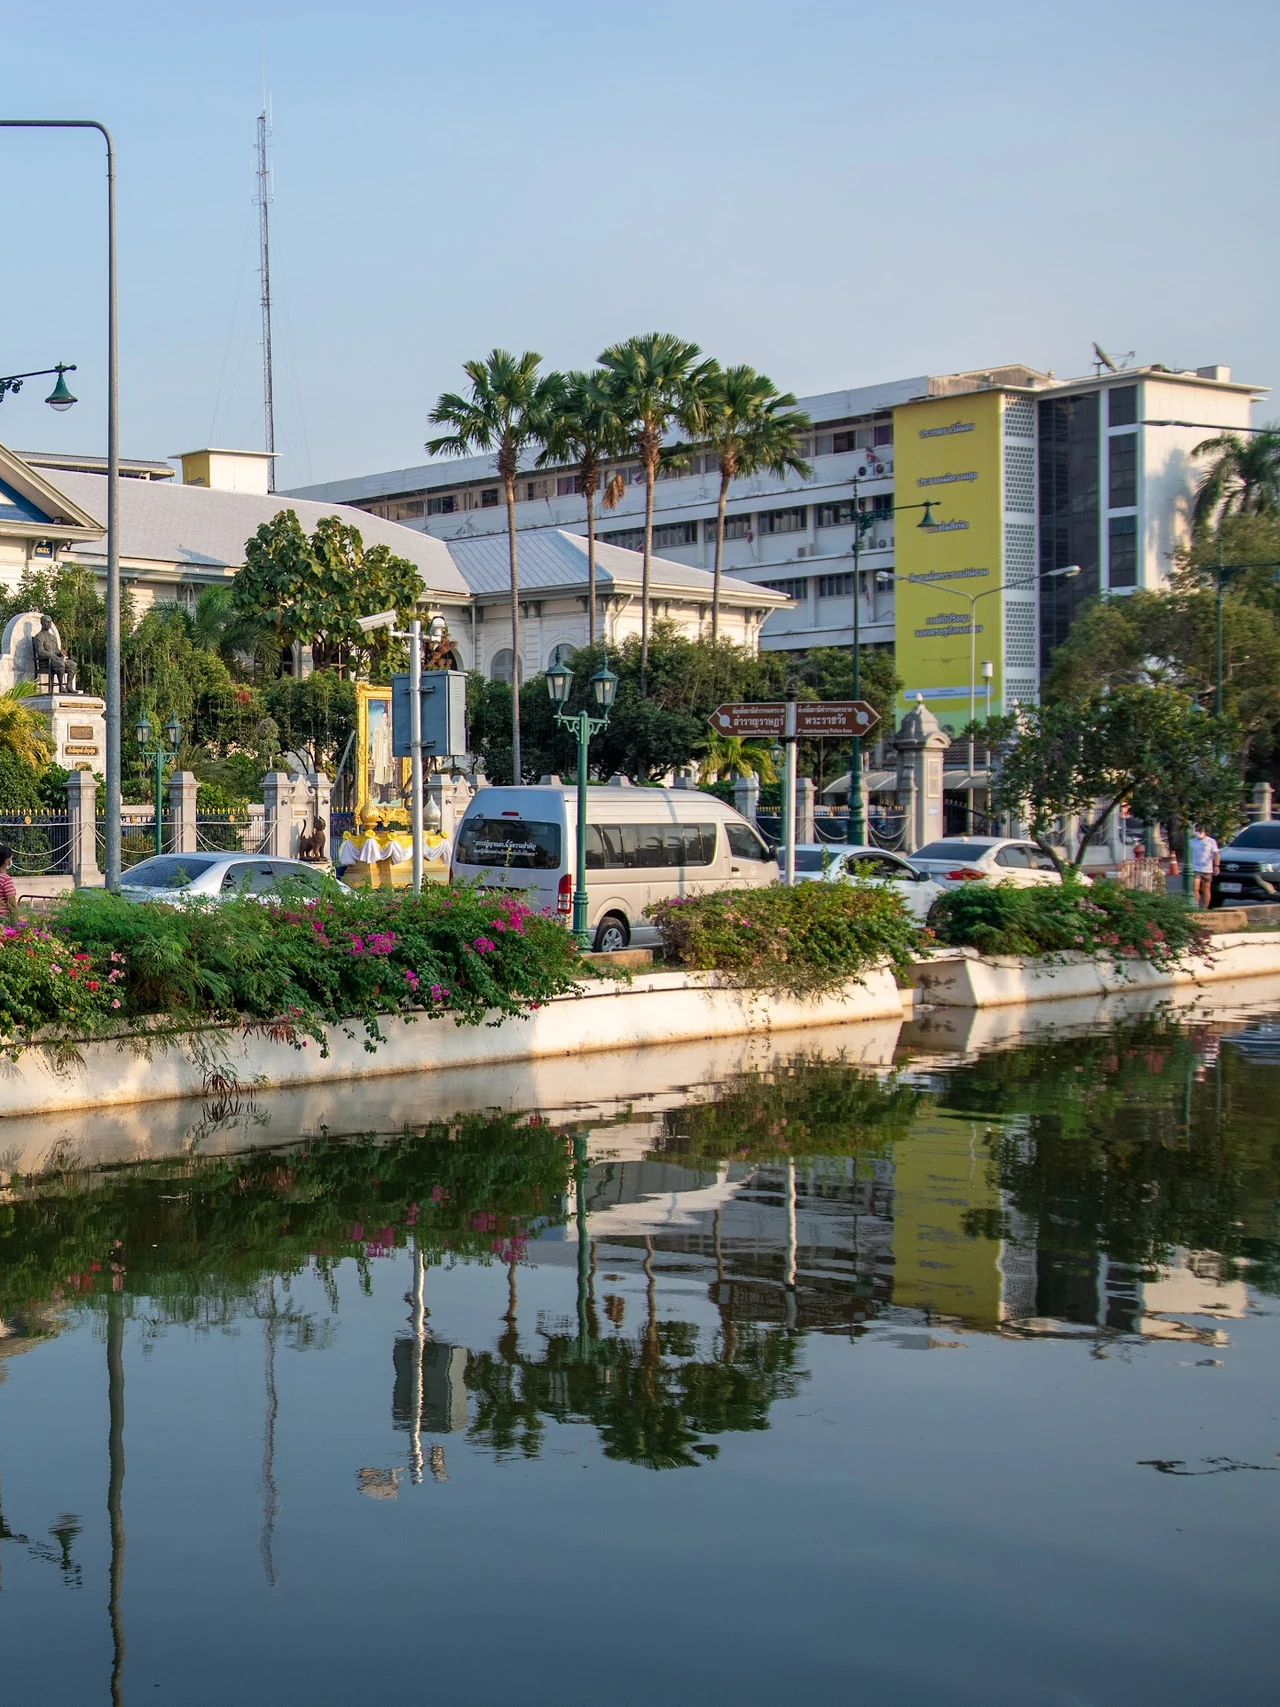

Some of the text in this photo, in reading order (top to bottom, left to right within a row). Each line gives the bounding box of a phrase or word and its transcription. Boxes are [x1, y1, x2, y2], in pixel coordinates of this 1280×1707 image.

[734, 715, 785, 728] สำราญราษฎร์
[805, 713, 847, 725] พระราชวัง
